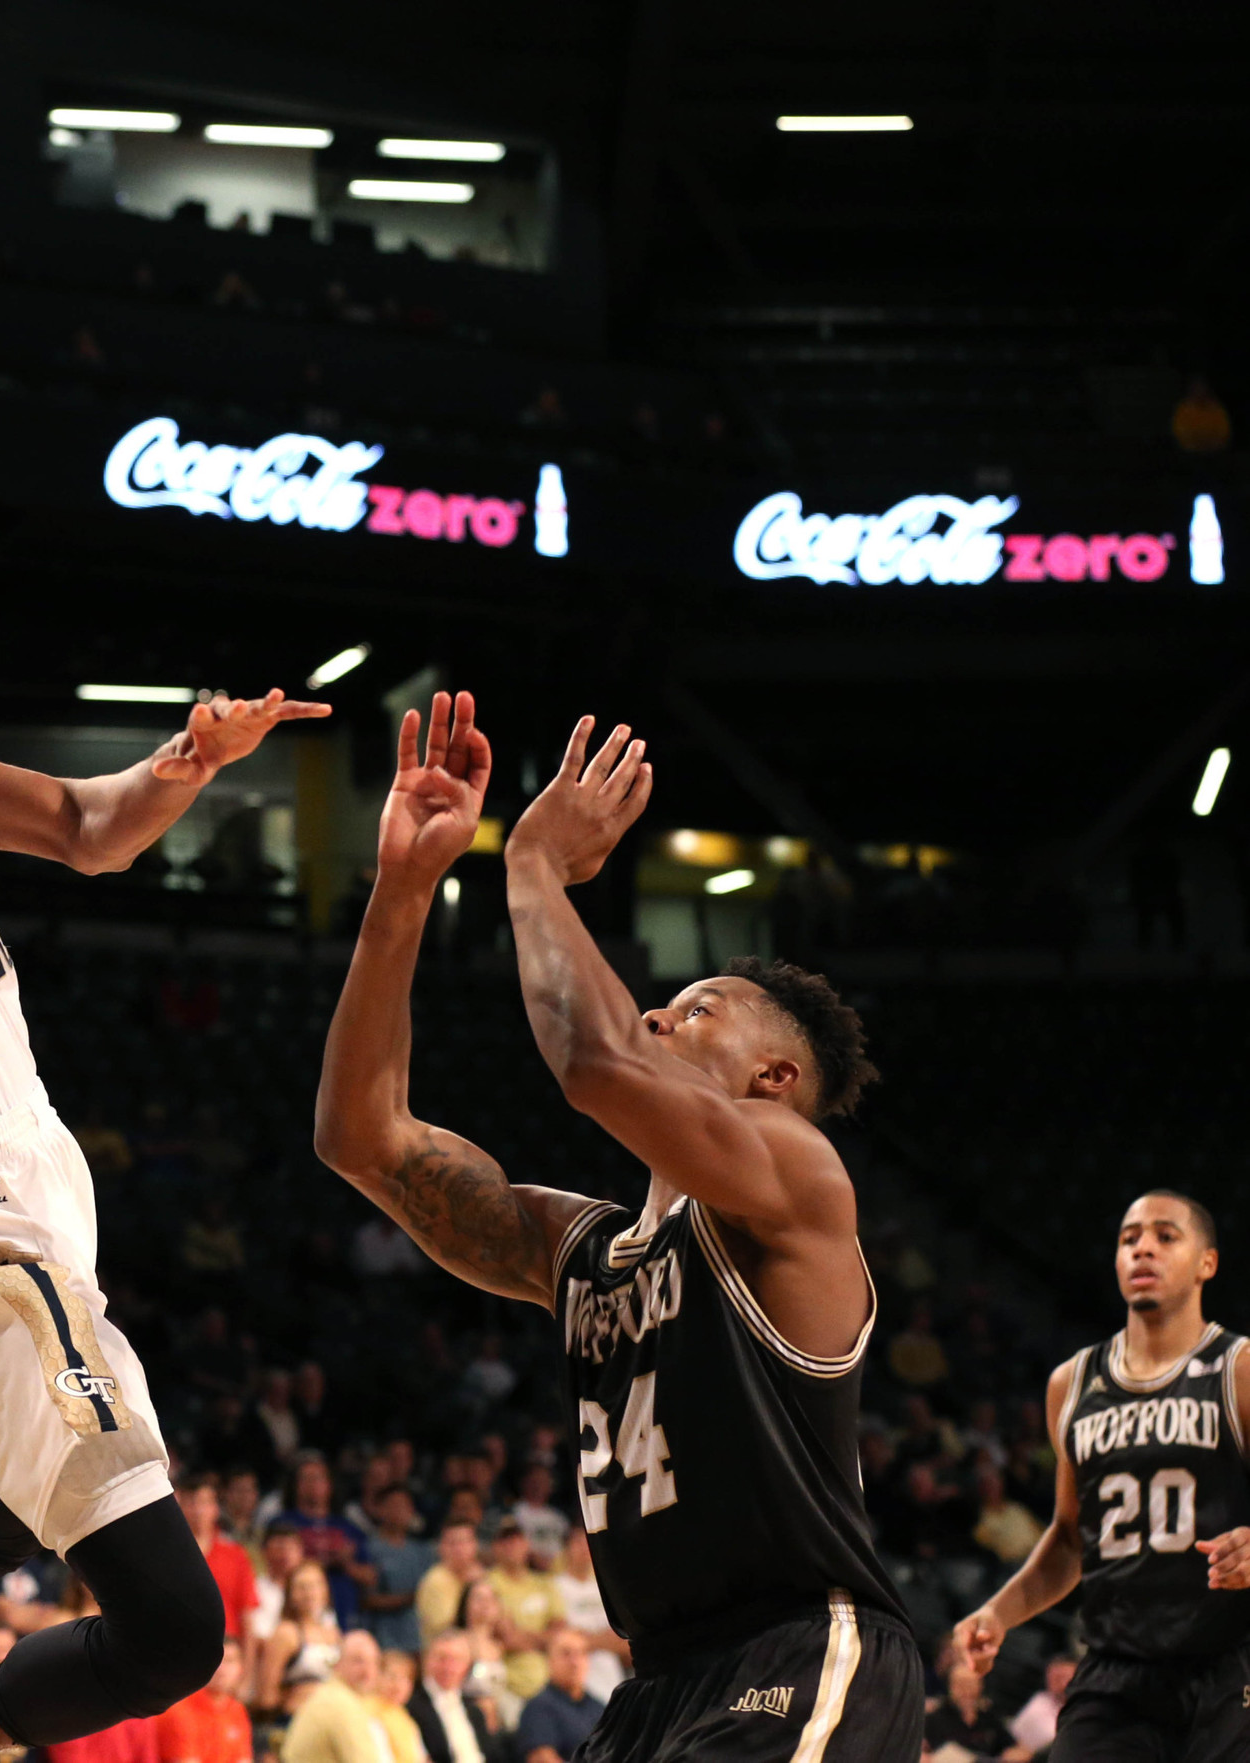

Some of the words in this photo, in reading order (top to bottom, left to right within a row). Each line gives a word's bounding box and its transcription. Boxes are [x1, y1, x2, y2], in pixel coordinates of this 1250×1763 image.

[367, 484, 519, 548] zero
[1003, 533, 1170, 582] zero
[54, 1365, 116, 1404] GT
[577, 1370, 678, 1534] 24
[1073, 1397, 1220, 1467] WOFFORD
[1098, 1467, 1197, 1560] 20
